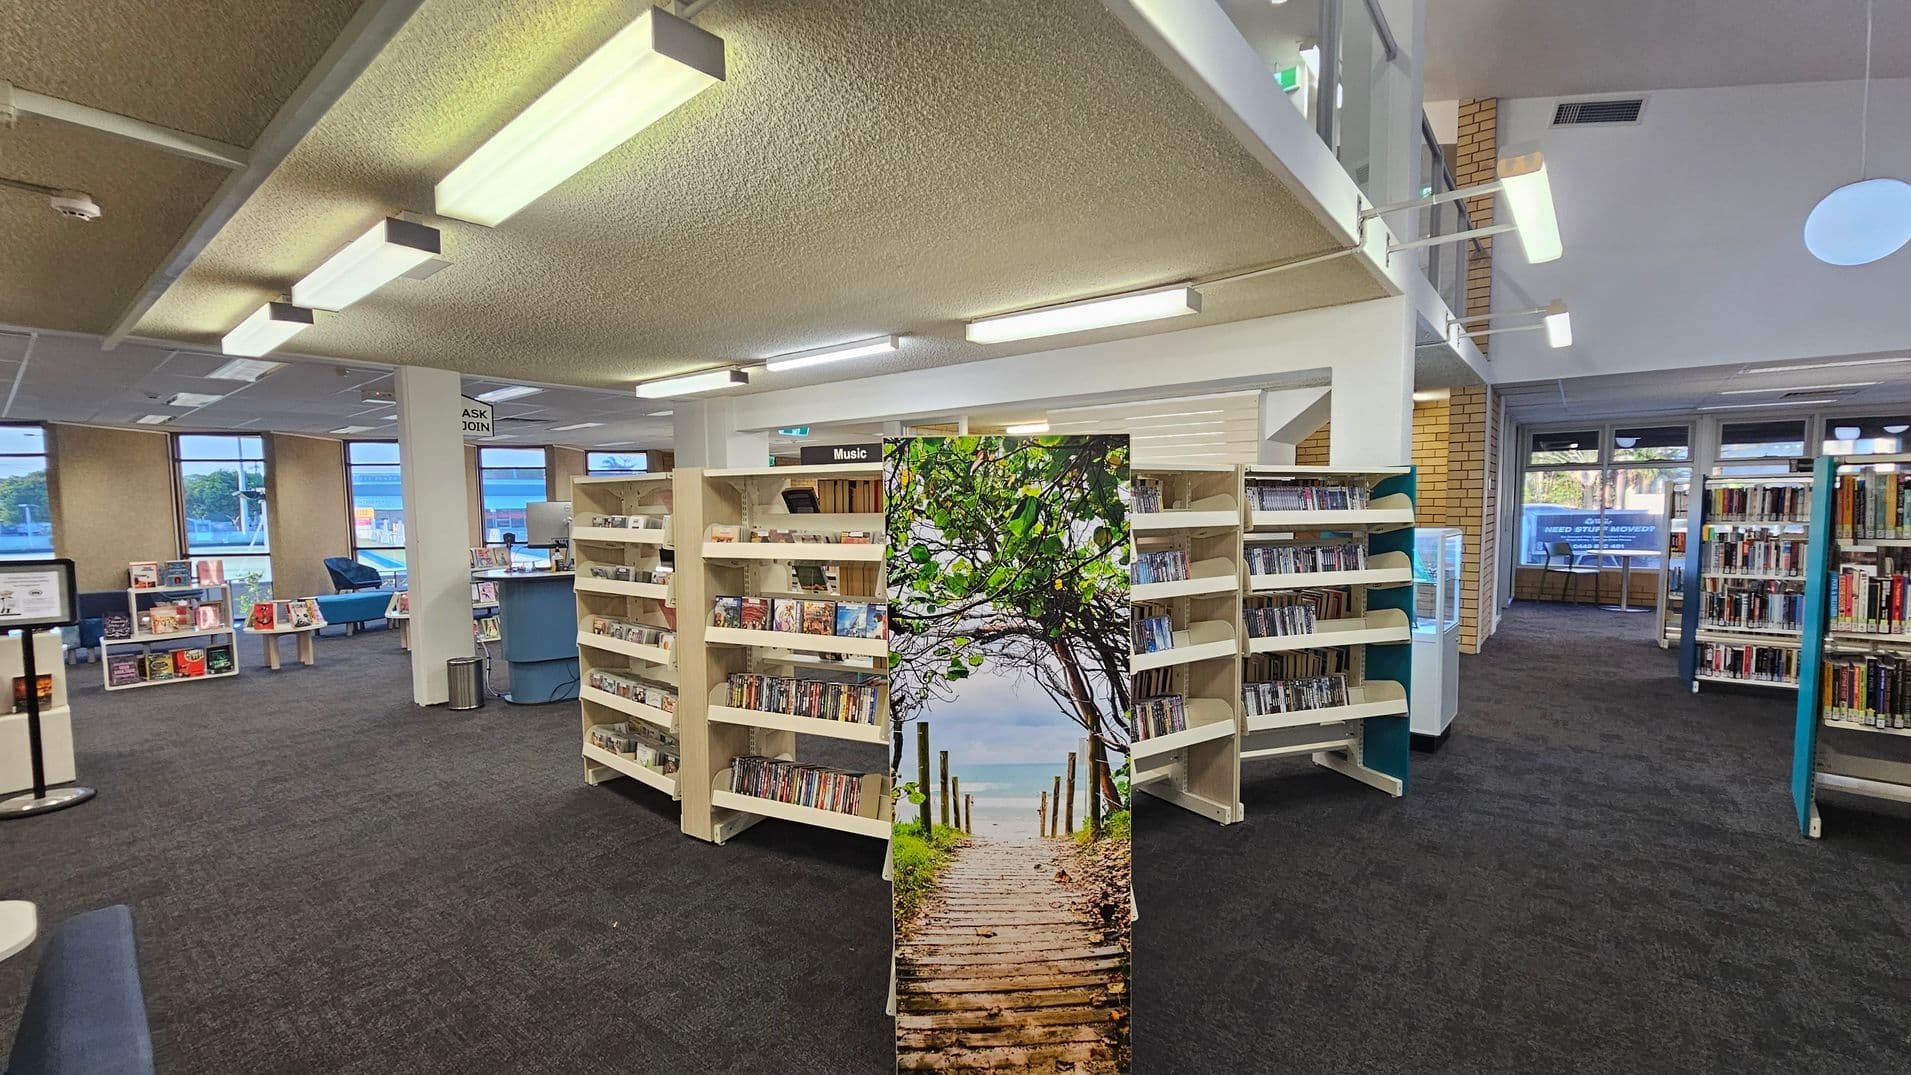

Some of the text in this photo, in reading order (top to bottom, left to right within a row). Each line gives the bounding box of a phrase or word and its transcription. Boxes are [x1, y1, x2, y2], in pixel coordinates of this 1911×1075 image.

[462, 409, 488, 419] ASK
[462, 421, 490, 432] JOIN
[833, 447, 868, 460] Music
[1610, 525, 1656, 533] MOVED?
